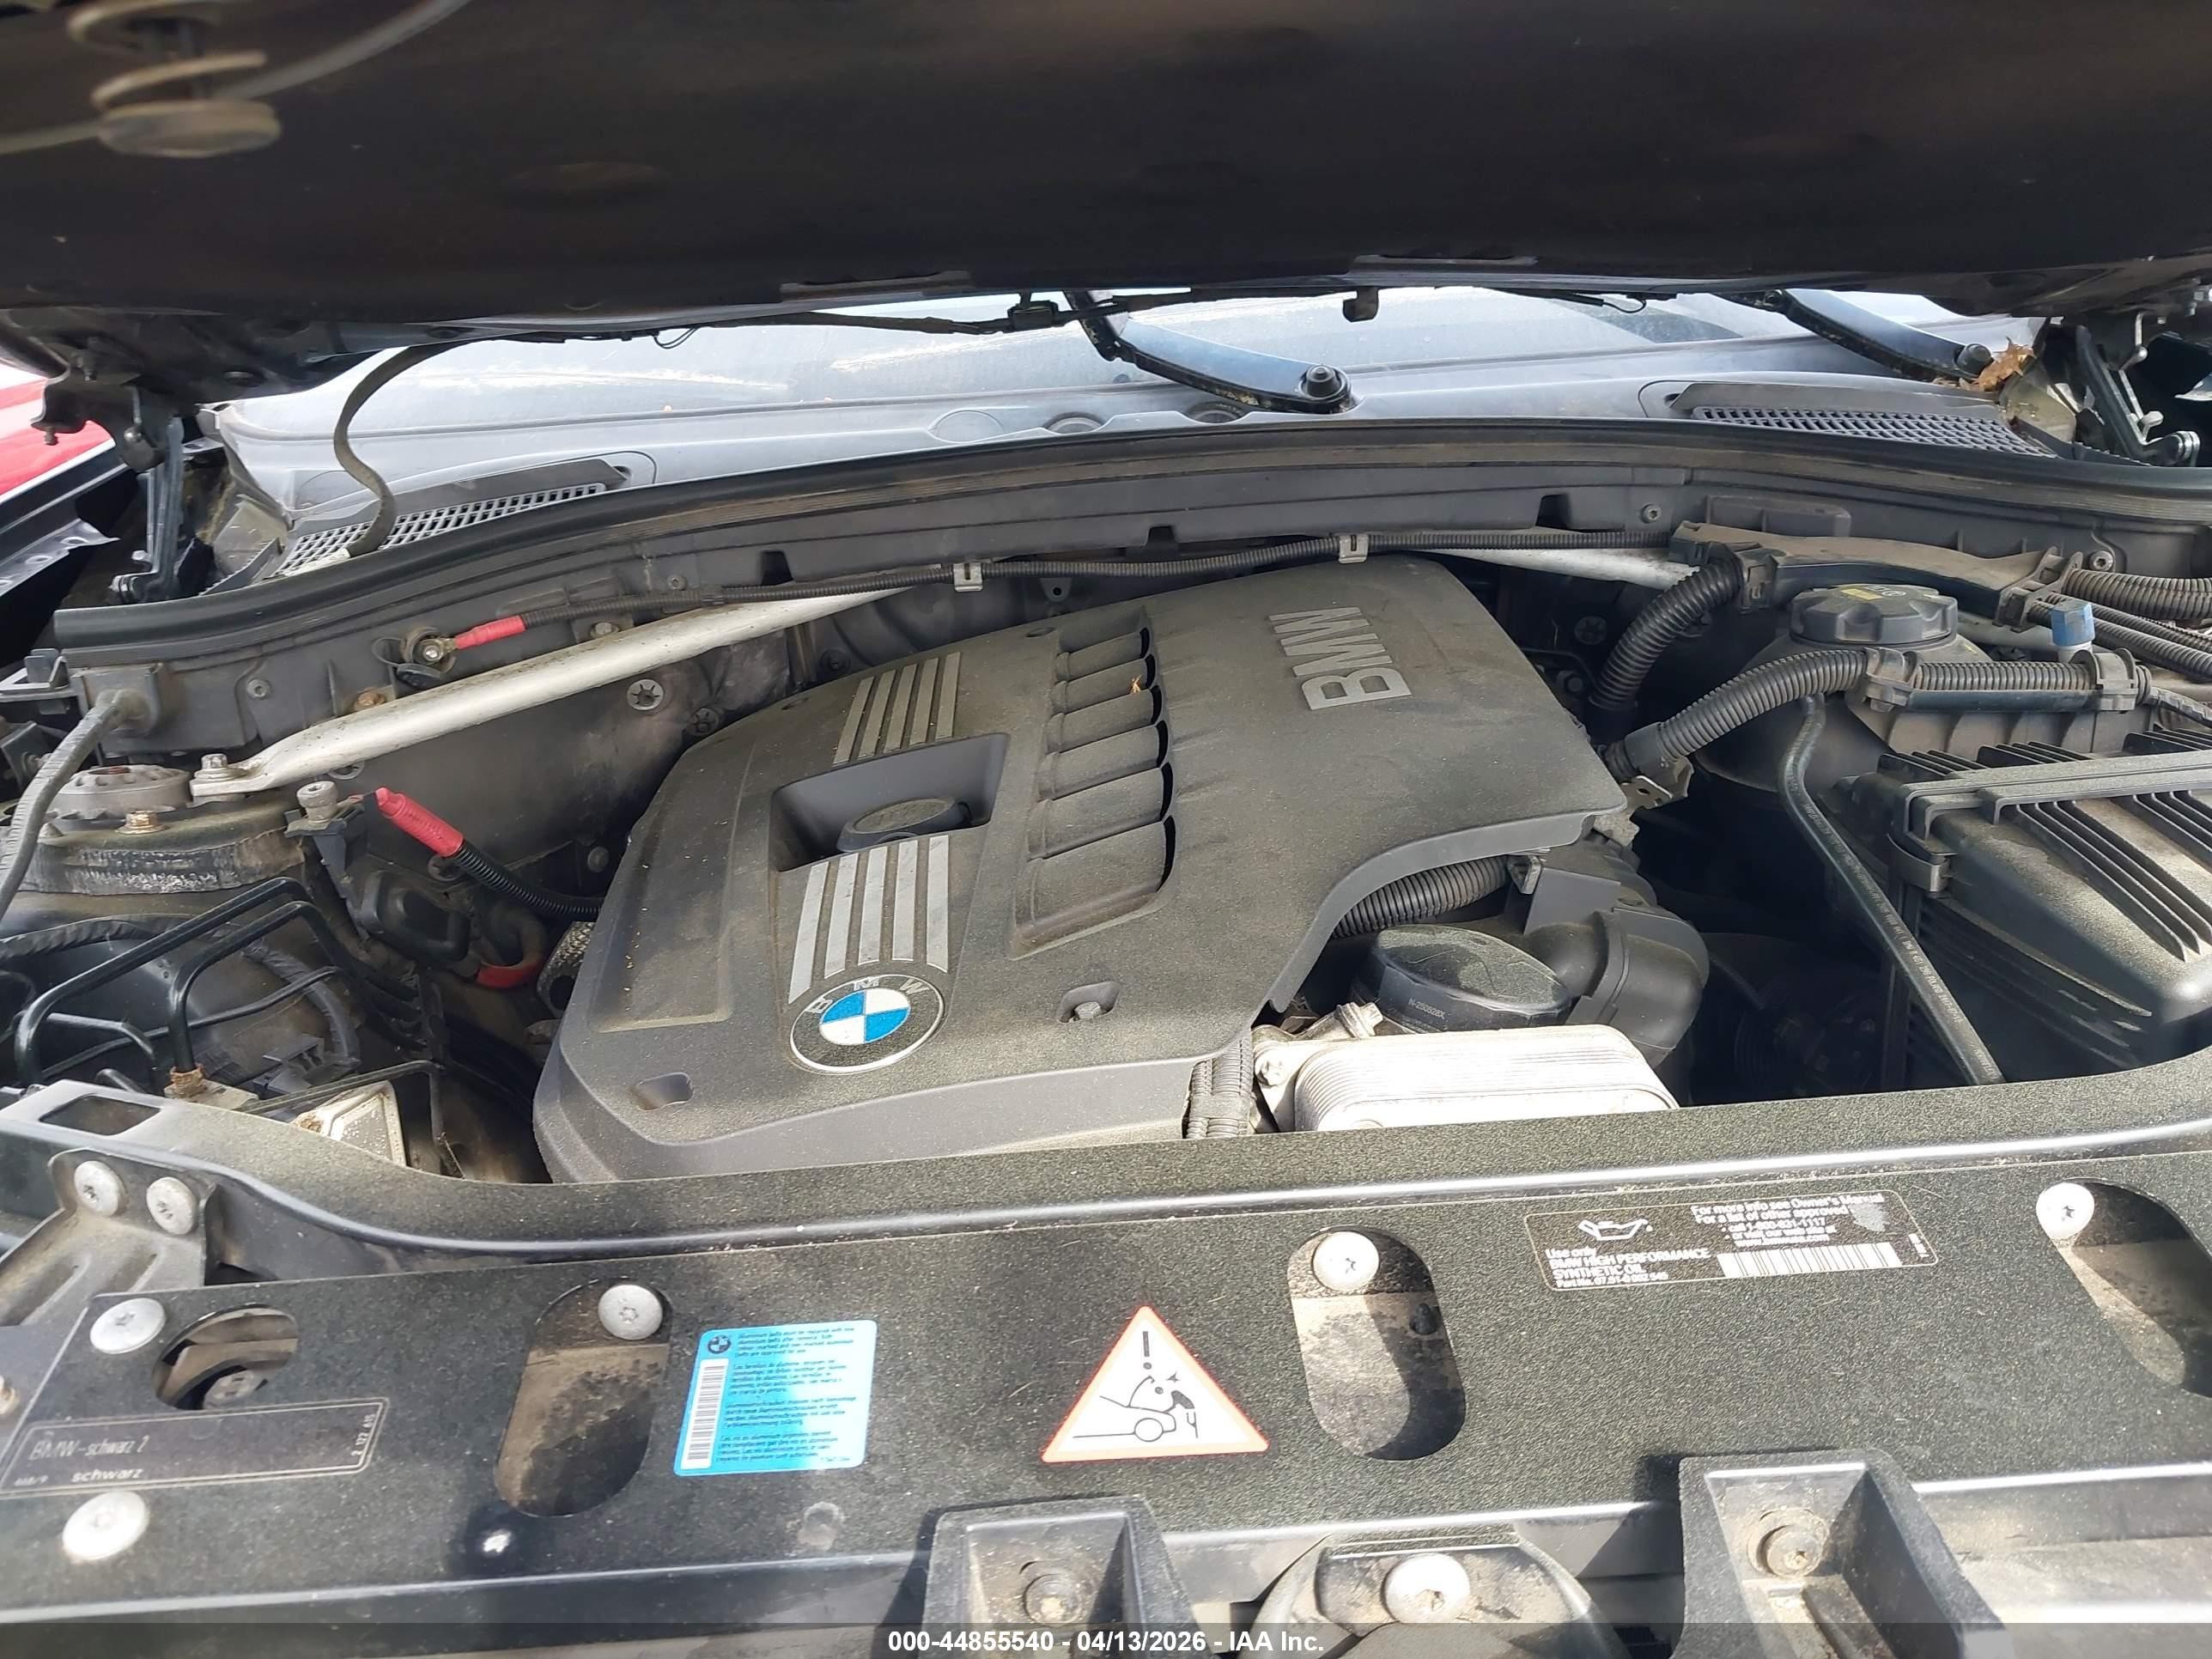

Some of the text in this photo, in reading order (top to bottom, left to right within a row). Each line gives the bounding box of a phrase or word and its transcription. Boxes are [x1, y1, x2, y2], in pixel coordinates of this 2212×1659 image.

[1268, 606, 1413, 711] BMW
[1690, 1205, 1711, 1216] For
[1713, 1203, 1744, 1214] more
[1790, 1195, 1839, 1209] Owner's
[1695, 1213, 1716, 1224] For
[1546, 1246, 1597, 1259] Use only
[1549, 1248, 1711, 1270] BMW HIGH PERFORMANCE
[1553, 1263, 1647, 1281] SYNTHETIC OIL
[29, 1431, 136, 1461] BMW-schwarz
[70, 1468, 144, 1483] schwarz
